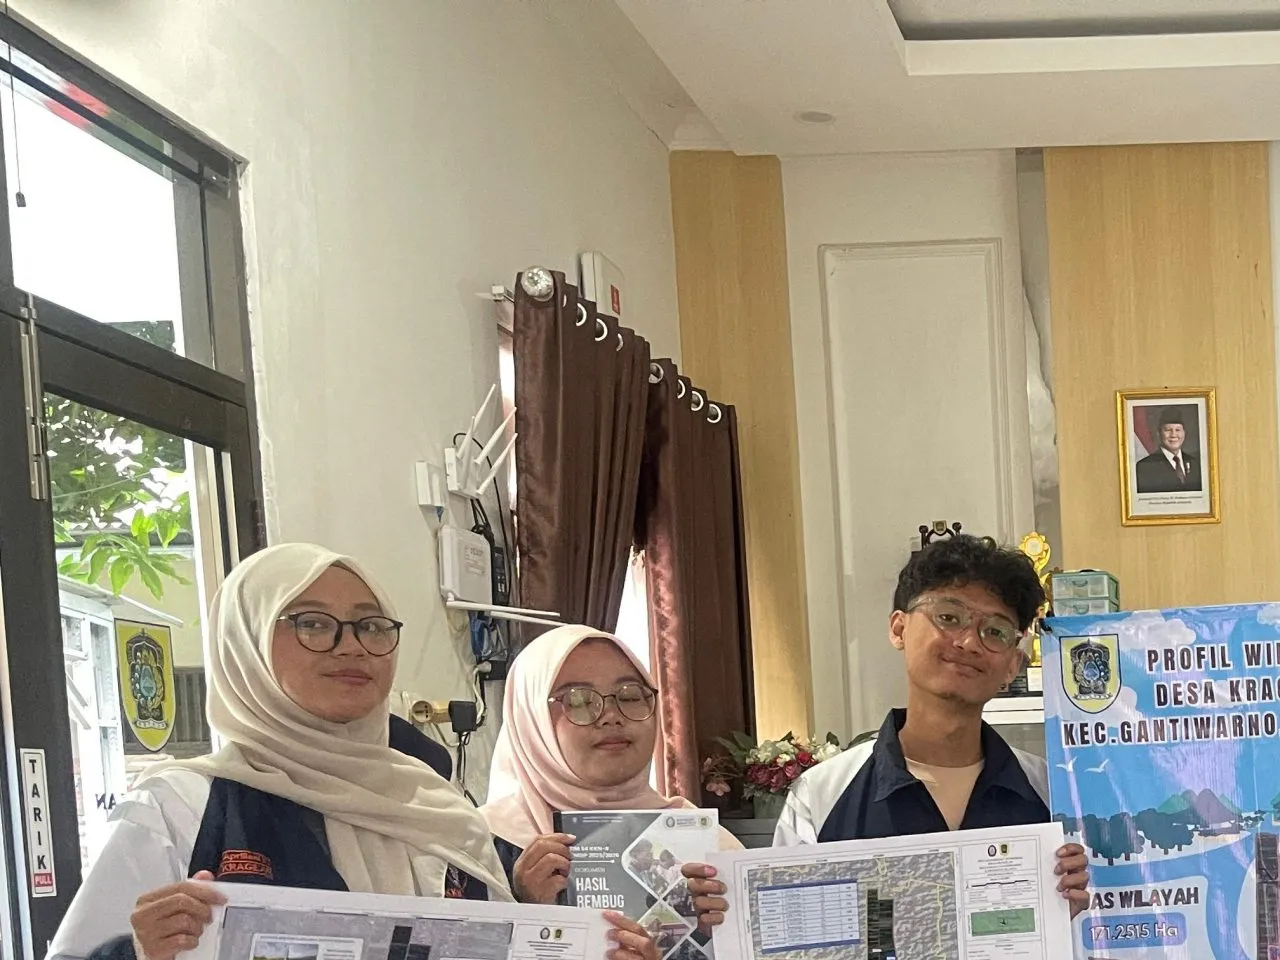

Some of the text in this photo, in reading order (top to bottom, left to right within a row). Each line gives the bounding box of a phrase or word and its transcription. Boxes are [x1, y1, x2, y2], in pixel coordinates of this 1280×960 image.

[1148, 646, 1232, 673] PROFIL
[1155, 678, 1216, 708] DESA
[29, 759, 47, 870] TARIK
[575, 877, 610, 891] HASIL
[576, 894, 625, 909] REMBUG
[1119, 887, 1200, 909] WILAYAH
[1154, 921, 1178, 938] Ha
